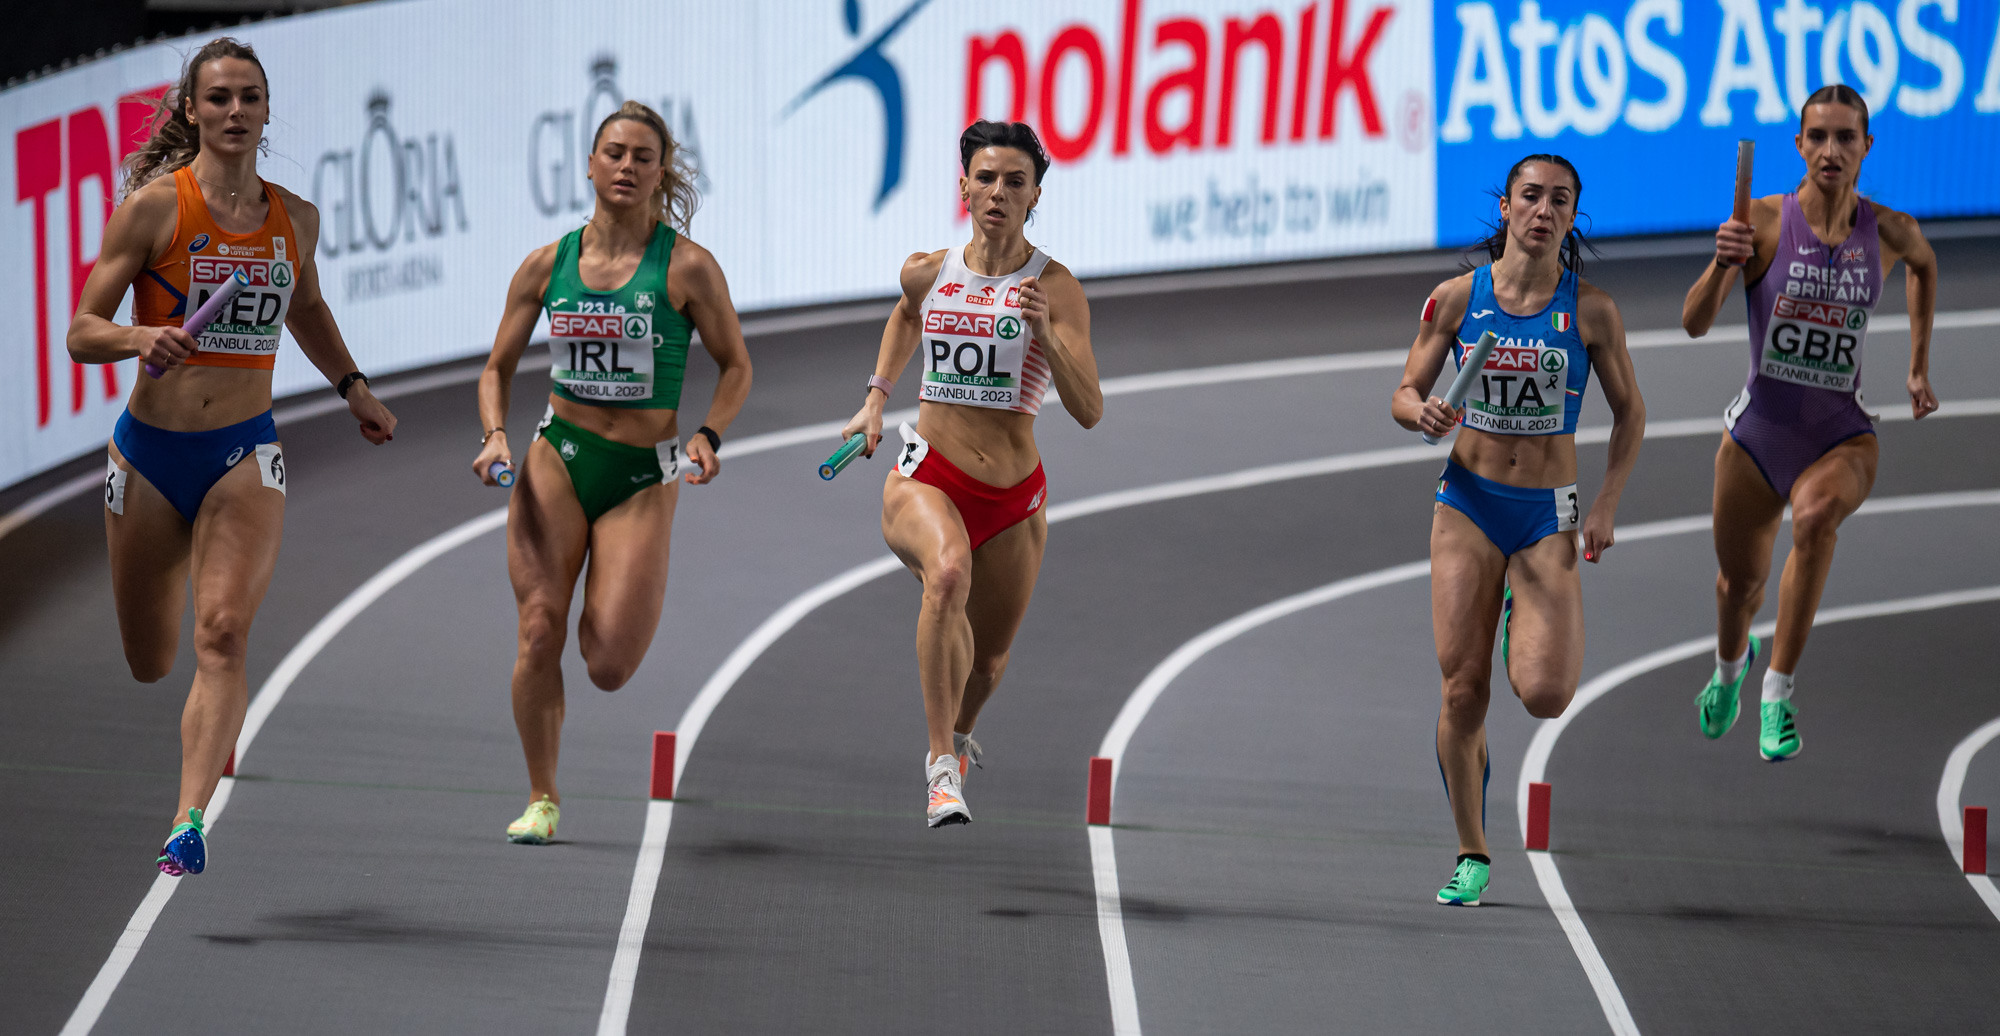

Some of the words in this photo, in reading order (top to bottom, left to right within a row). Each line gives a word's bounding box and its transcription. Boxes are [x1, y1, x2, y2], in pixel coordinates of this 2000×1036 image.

[955, 0, 1397, 227] polanik
[312, 112, 469, 258] GLORIA
[1147, 195, 1199, 242] we
[1207, 176, 1279, 238] help
[1327, 168, 1390, 229] win
[194, 262, 268, 283] SPAR
[1789, 262, 1868, 284] GREAT
[967, 296, 993, 305] ORLEN
[1786, 280, 1870, 302] BRITAIN
[1776, 299, 1845, 325] SPAR
[213, 323, 234, 332] RUN
[553, 316, 621, 336] SPAR
[926, 313, 992, 334] SPAR
[1771, 323, 1857, 367] GBR
[567, 341, 634, 373] IRL
[930, 339, 1011, 378] POL
[1464, 349, 1537, 369] PAR
[942, 374, 960, 383] RUN
[1766, 363, 1821, 384] ISTANBUL
[615, 386, 645, 397] 2023
[981, 390, 1012, 402] 2023
[1481, 374, 1546, 408] ITA
[1488, 405, 1506, 414] RUN
[1471, 412, 1526, 431] ISTANBUL
[1528, 418, 1557, 431] 2023
[106, 471, 116, 504] 6
[1567, 492, 1579, 524] 3
